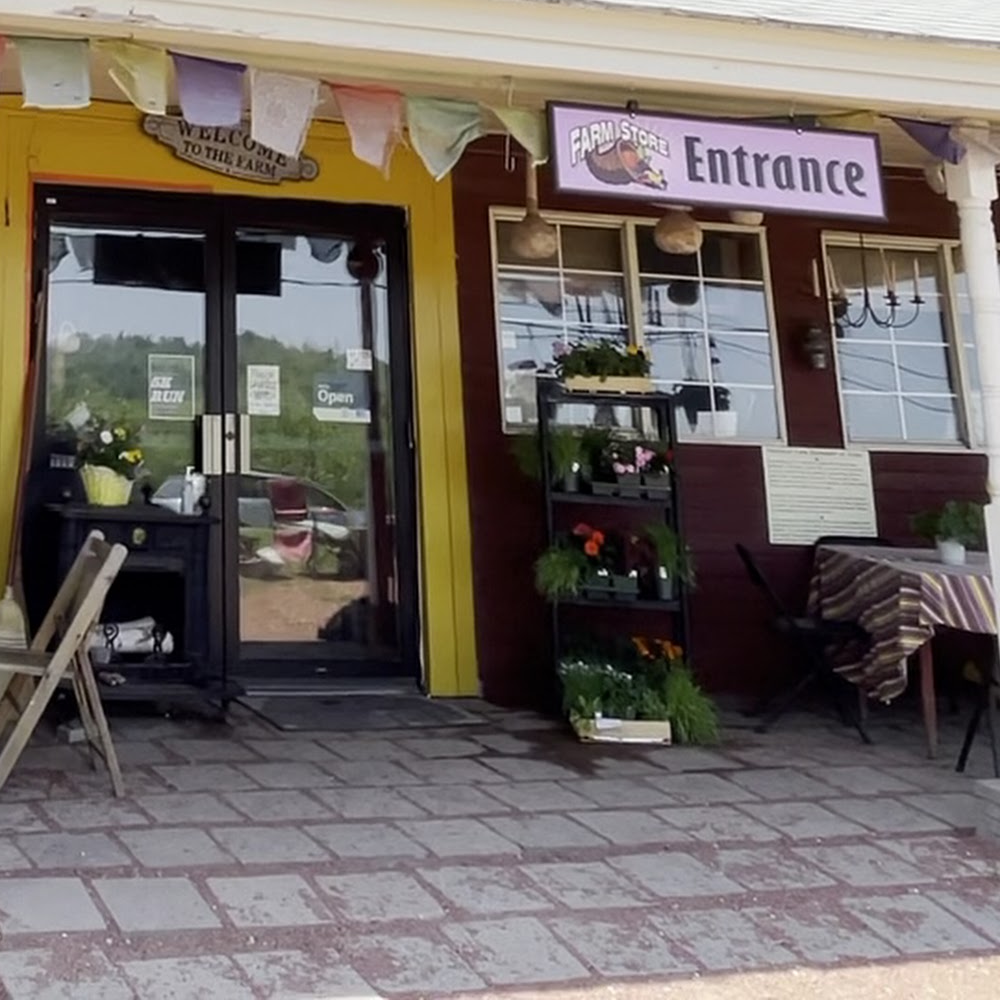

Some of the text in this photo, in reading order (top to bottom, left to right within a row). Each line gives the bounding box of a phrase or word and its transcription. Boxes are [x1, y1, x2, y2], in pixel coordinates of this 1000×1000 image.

[183, 140, 277, 178] TO THE FARM
[569, 119, 670, 167] FARM STORE
[684, 135, 867, 197] Entrance
[317, 388, 354, 406] Open
